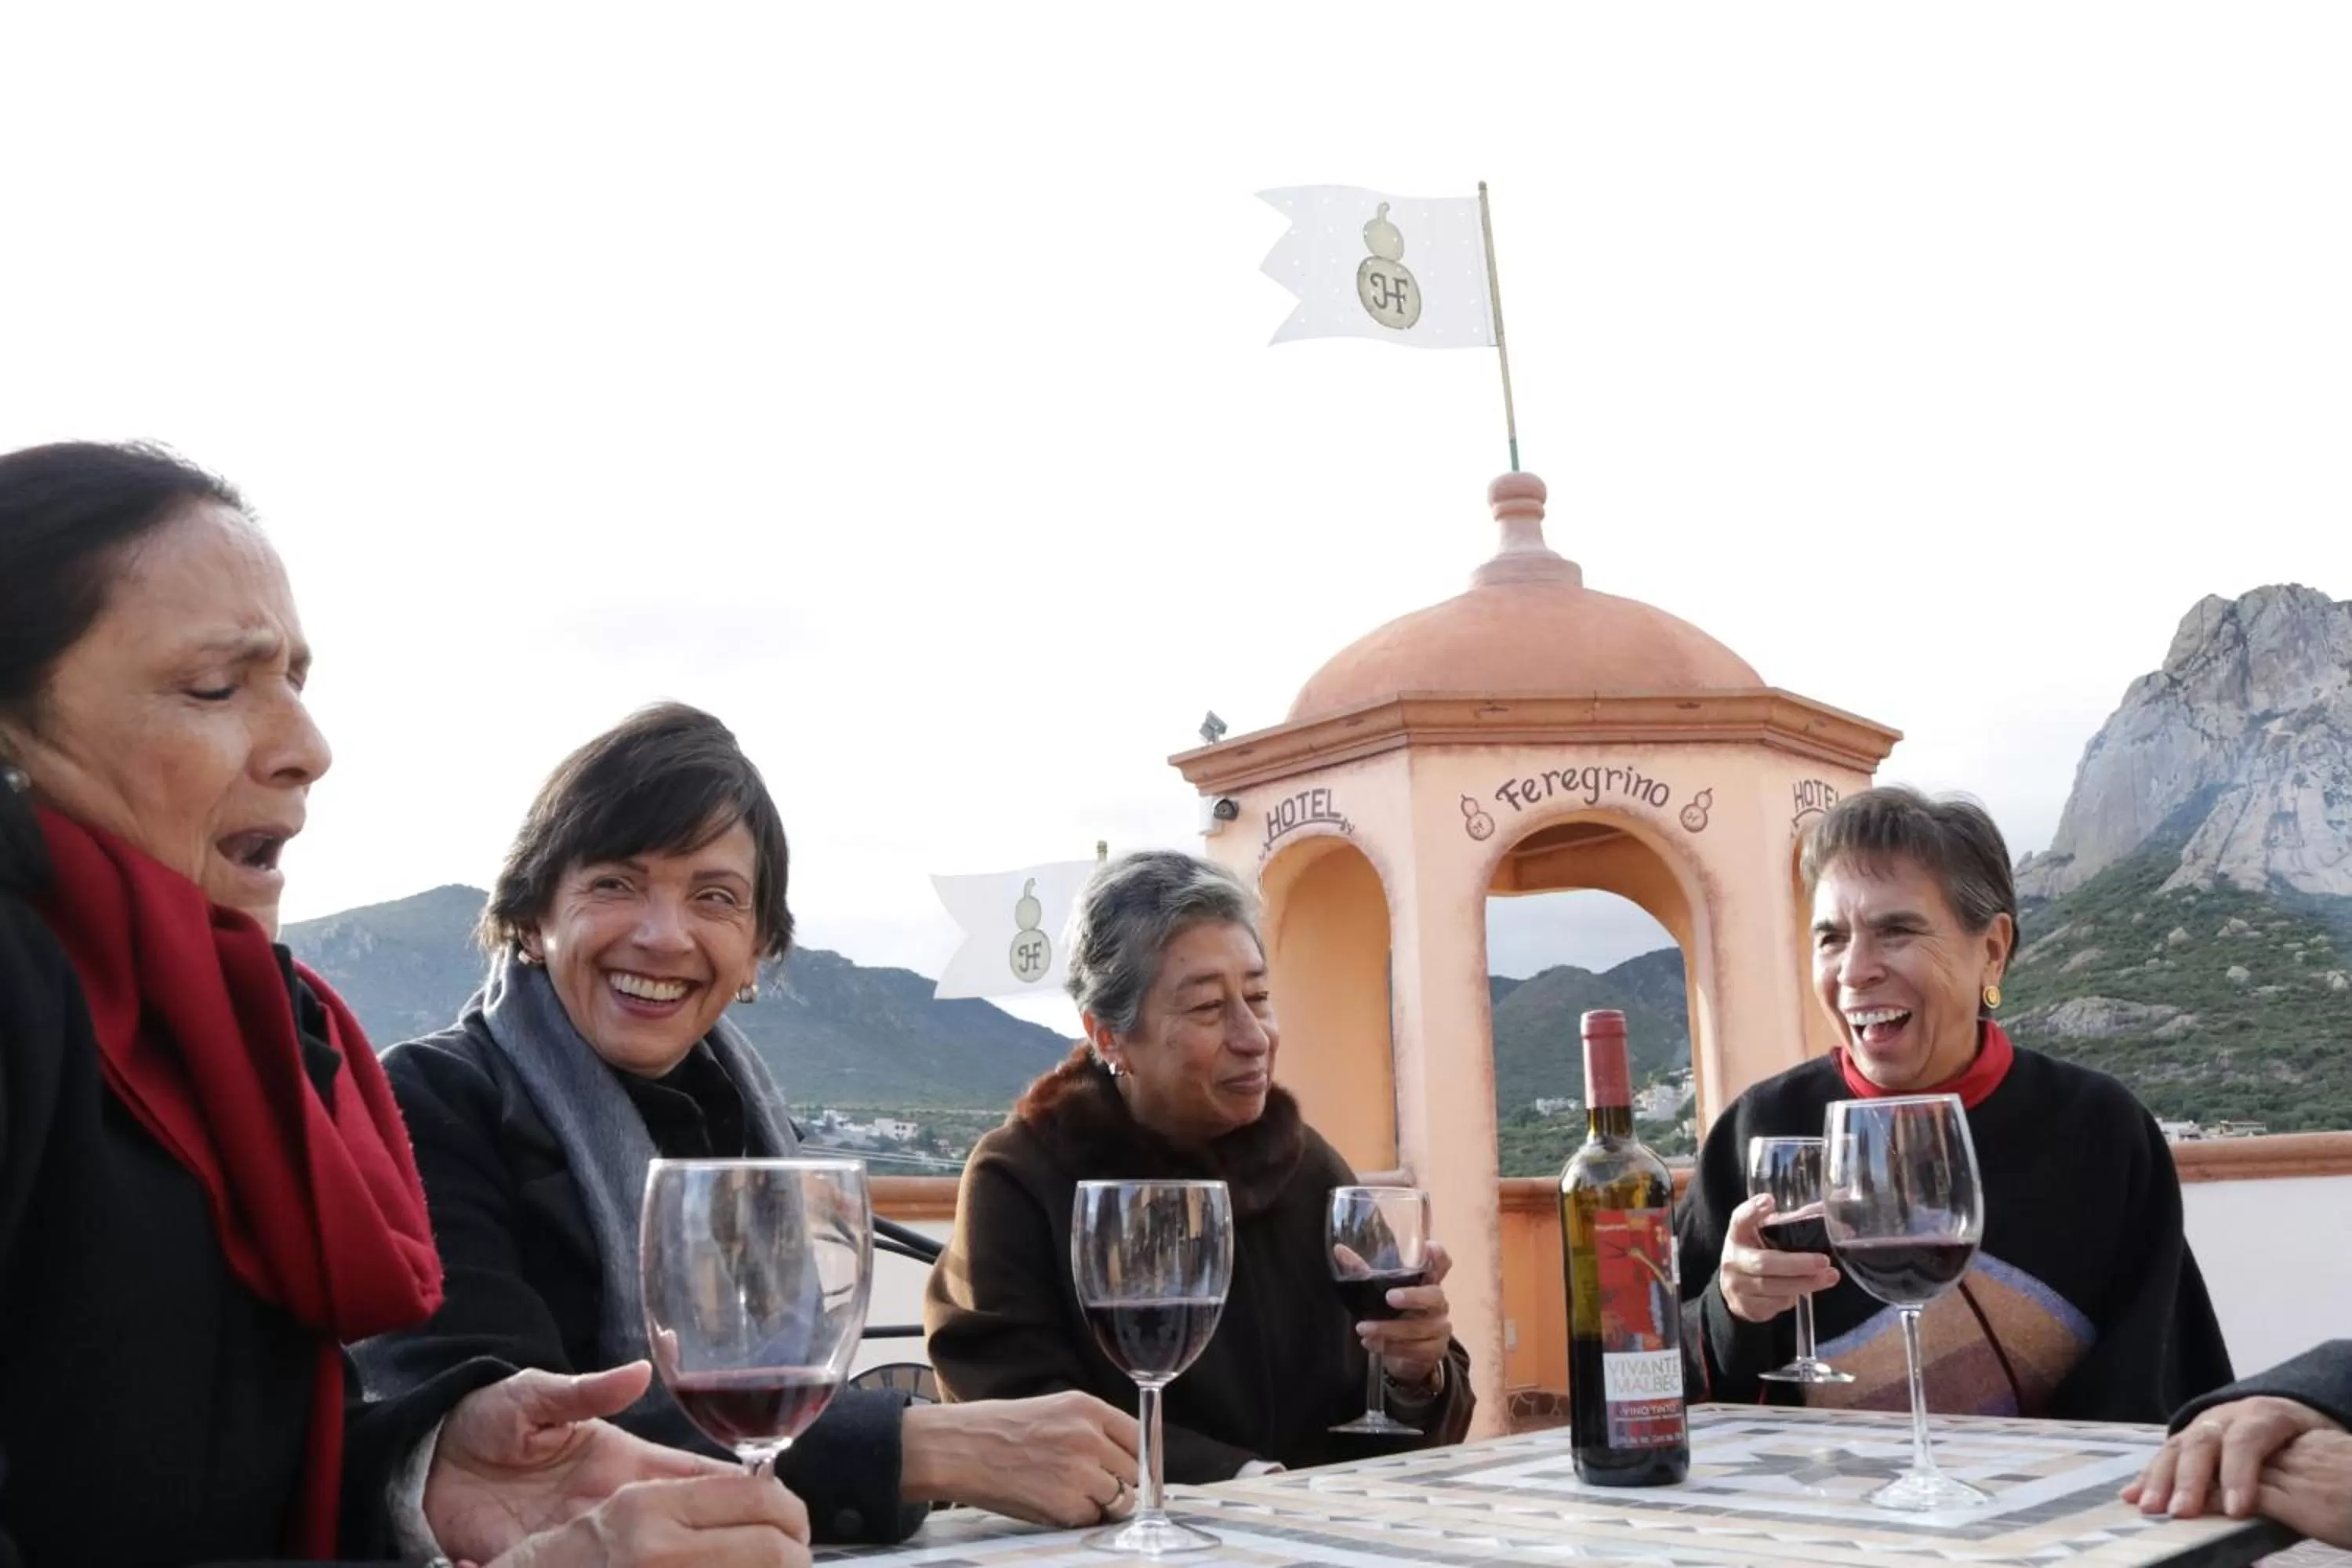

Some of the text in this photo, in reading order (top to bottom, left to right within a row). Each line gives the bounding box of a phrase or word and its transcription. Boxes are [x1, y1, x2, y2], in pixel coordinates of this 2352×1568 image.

[1495, 765, 1671, 811] Feregrino
[1266, 789, 1341, 841] HOTEL
[1606, 1356, 1679, 1377] VIVANTE
[1614, 1374, 1679, 1393] MALBEC
